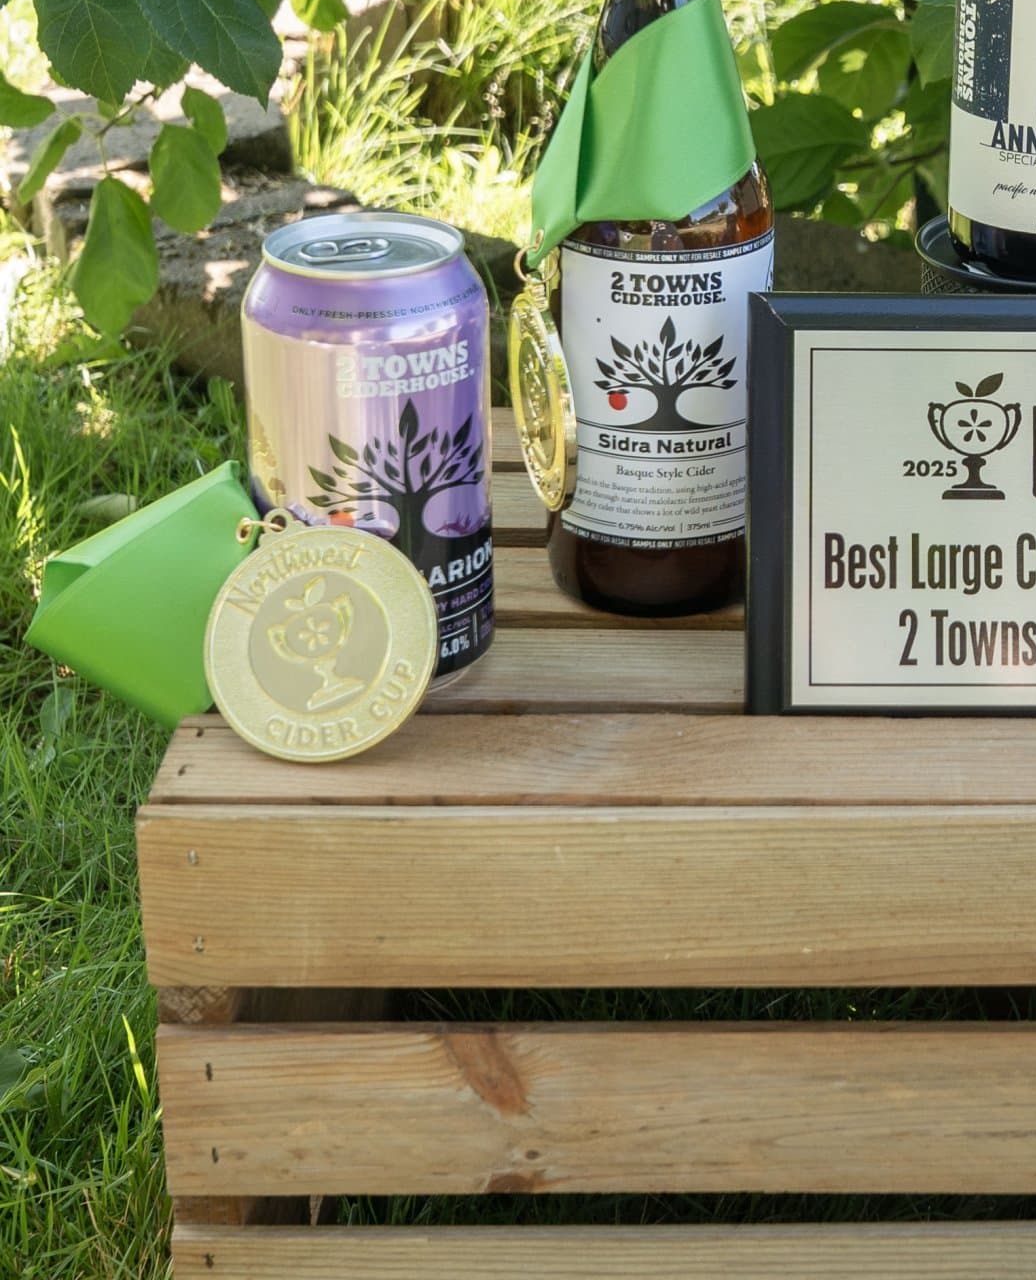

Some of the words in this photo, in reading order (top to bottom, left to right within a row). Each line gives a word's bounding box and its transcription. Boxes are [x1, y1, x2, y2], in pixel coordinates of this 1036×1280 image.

[962, 3, 977, 102] TOWNS
[992, 182, 1029, 200] pacific
[635, 252, 660, 261] SAMPLE
[610, 271, 624, 291] 2
[629, 271, 723, 293] TOWNS
[610, 290, 727, 306] CIDERHOUSE.
[292, 305, 317, 316] ONLY
[318, 307, 407, 319] FRESH-PRESSED
[336, 357, 356, 382] 2
[362, 340, 469, 381] TOWNS
[336, 363, 475, 399] CIDERHOUSE.
[598, 433, 651, 453] Sidra
[656, 431, 732, 454] Natural
[616, 465, 653, 480] Basque
[656, 467, 683, 480] Style
[686, 464, 717, 478] Cider
[903, 460, 958, 477] 2025
[824, 532, 898, 589] Best
[911, 532, 1003, 595] Large
[225, 542, 371, 617] Northwest
[440, 634, 470, 658] 6.0%
[899, 608, 918, 666] 2
[266, 713, 363, 746] CIDER
[369, 658, 416, 720] CUP
